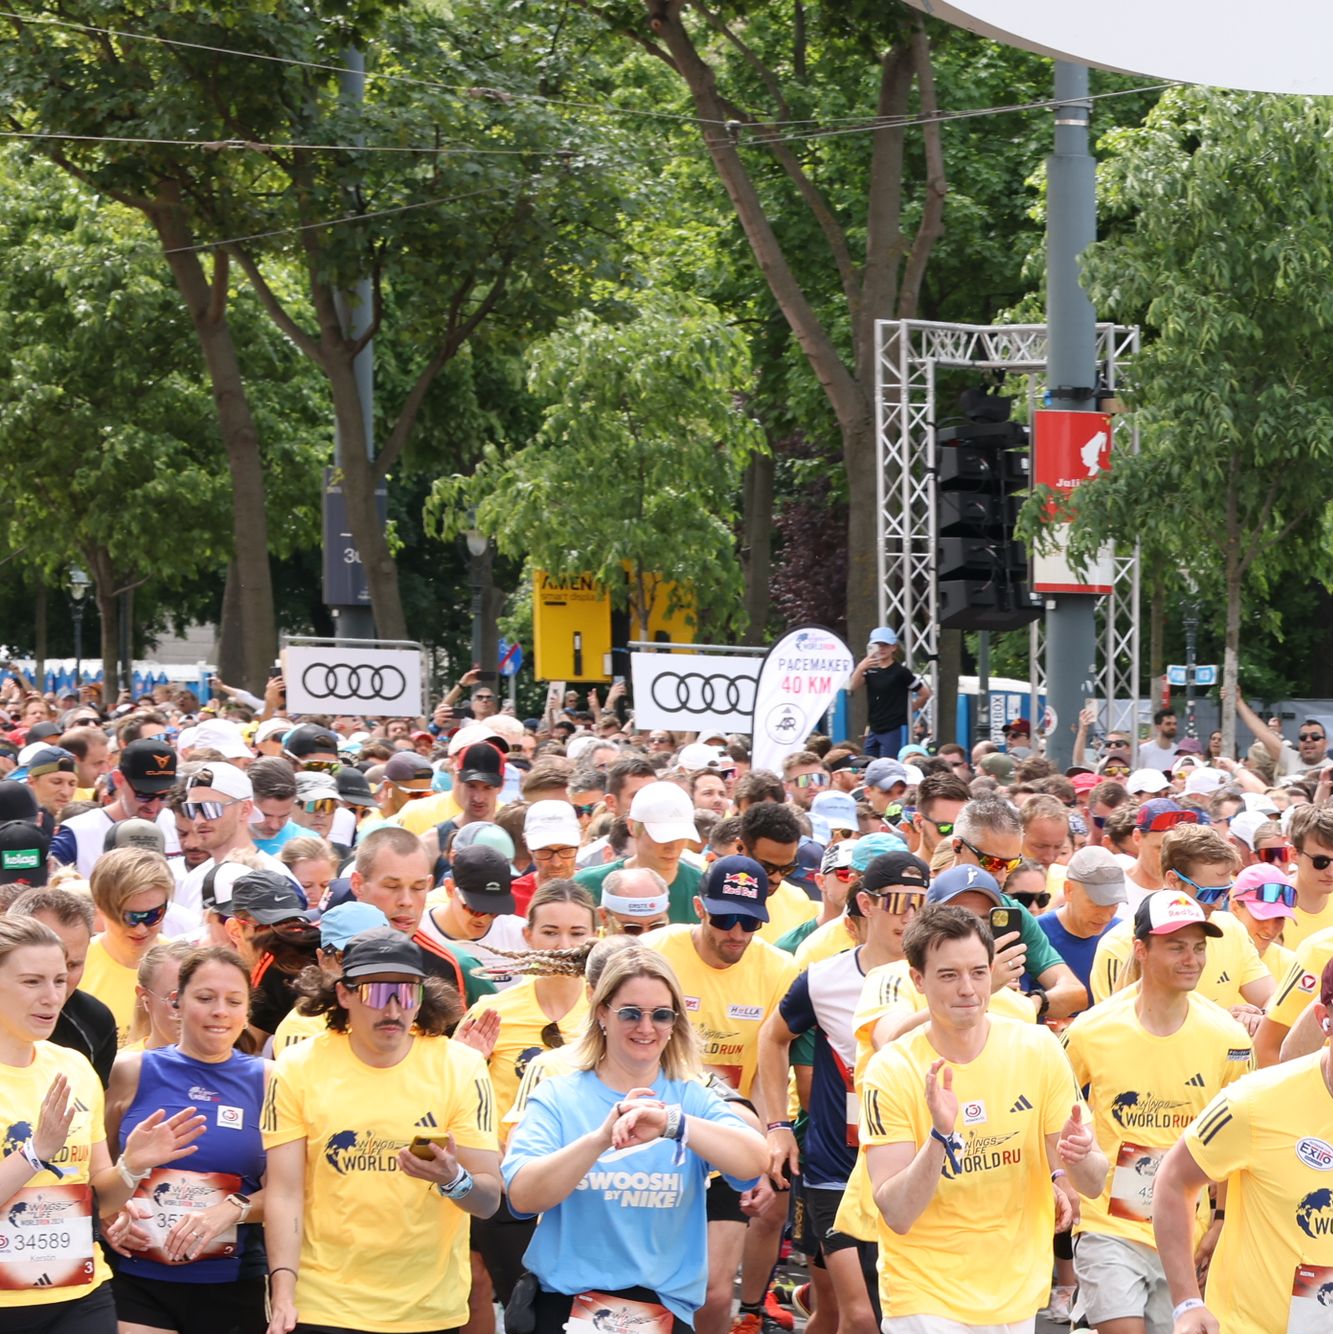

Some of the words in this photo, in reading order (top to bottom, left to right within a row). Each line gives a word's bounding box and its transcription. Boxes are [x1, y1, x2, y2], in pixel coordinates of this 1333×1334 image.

[777, 658, 851, 672] PACEMAKER
[781, 677, 801, 693] 40
[808, 676, 832, 694] KM
[722, 884, 740, 897] Red
[740, 886, 759, 900] Bull
[719, 1042, 744, 1056] RUN
[1125, 1112, 1171, 1129] WORLD
[343, 1155, 397, 1172] WORLD
[574, 1171, 680, 1192] SWOOSH
[603, 1189, 621, 1201] BY
[620, 1189, 679, 1209] NIKE
[13, 1232, 71, 1251] 34589
[84, 1261, 94, 1274] 3
